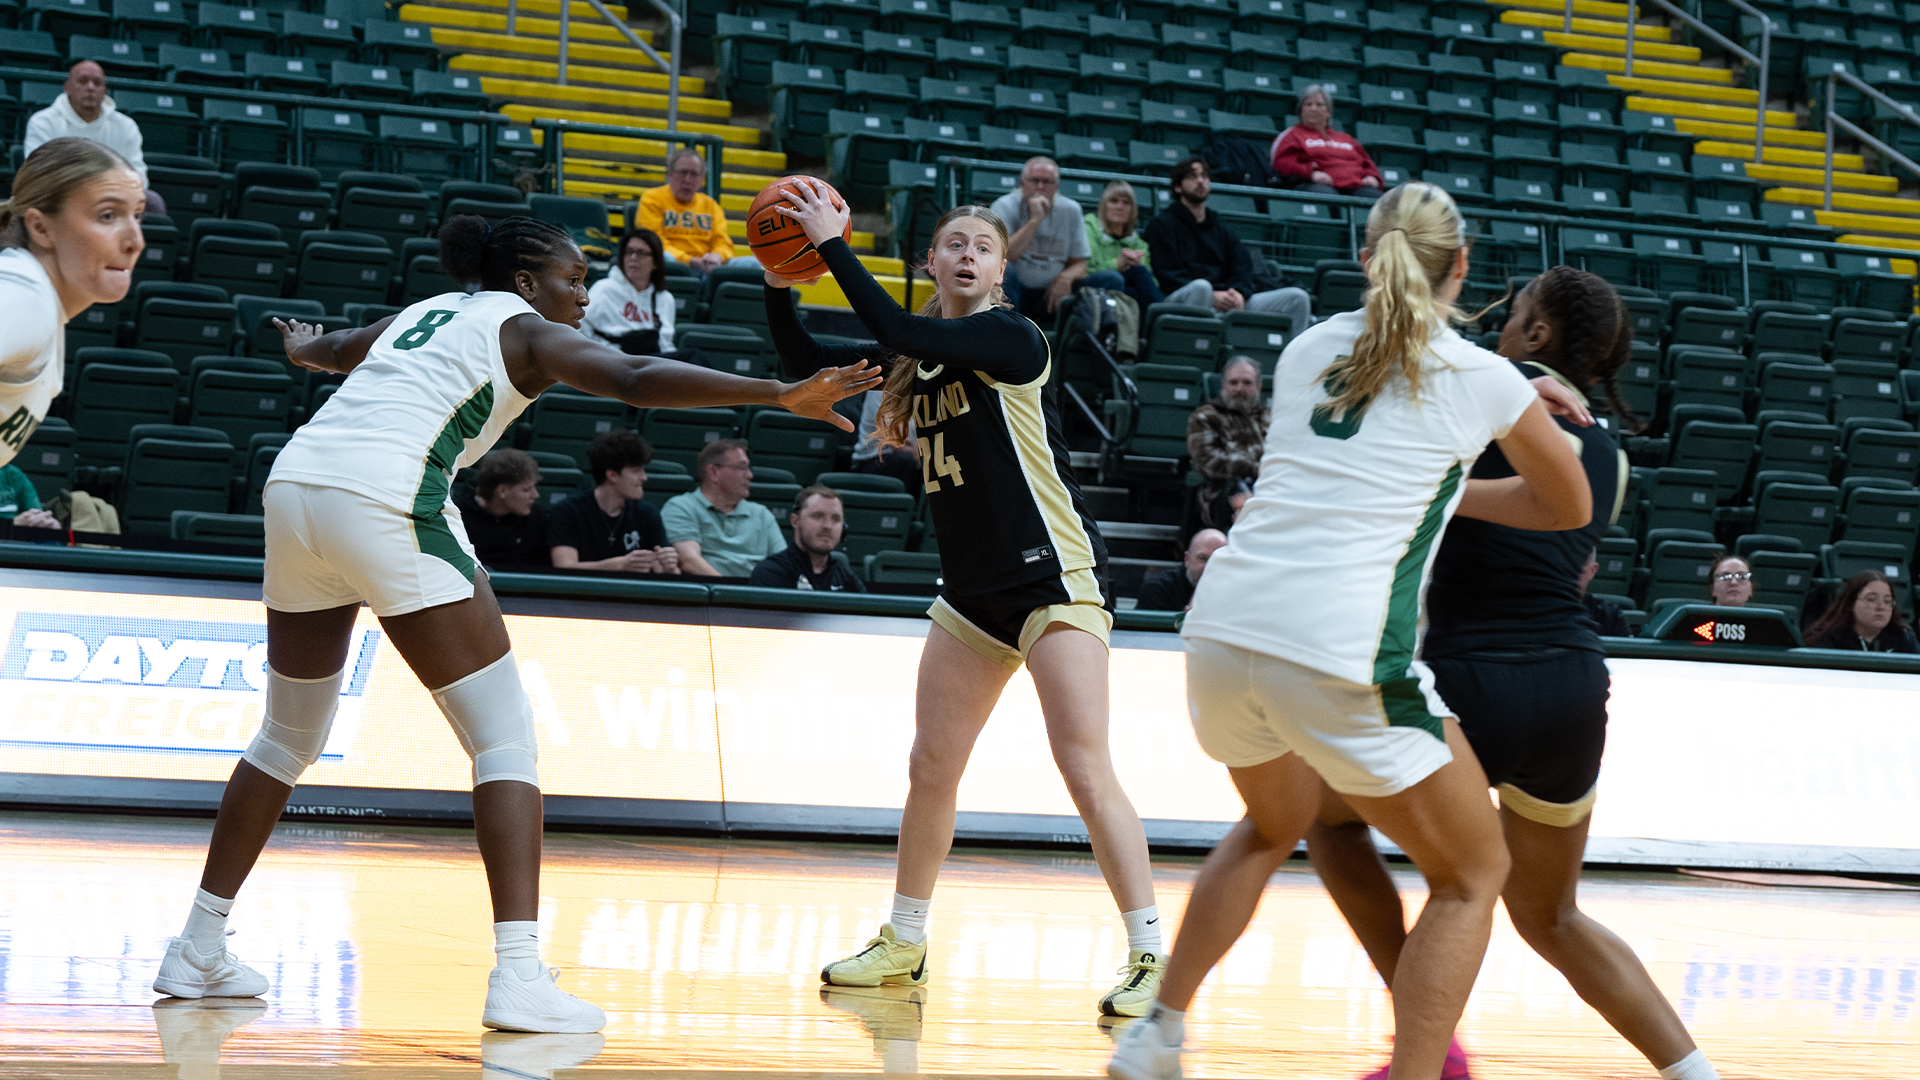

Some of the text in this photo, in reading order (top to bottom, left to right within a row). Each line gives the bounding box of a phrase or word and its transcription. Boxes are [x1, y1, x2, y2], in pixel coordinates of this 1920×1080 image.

[664, 210, 712, 231] WSU
[393, 309, 459, 350] 8
[917, 432, 965, 494] 24
[1715, 623, 1746, 641] POSS
